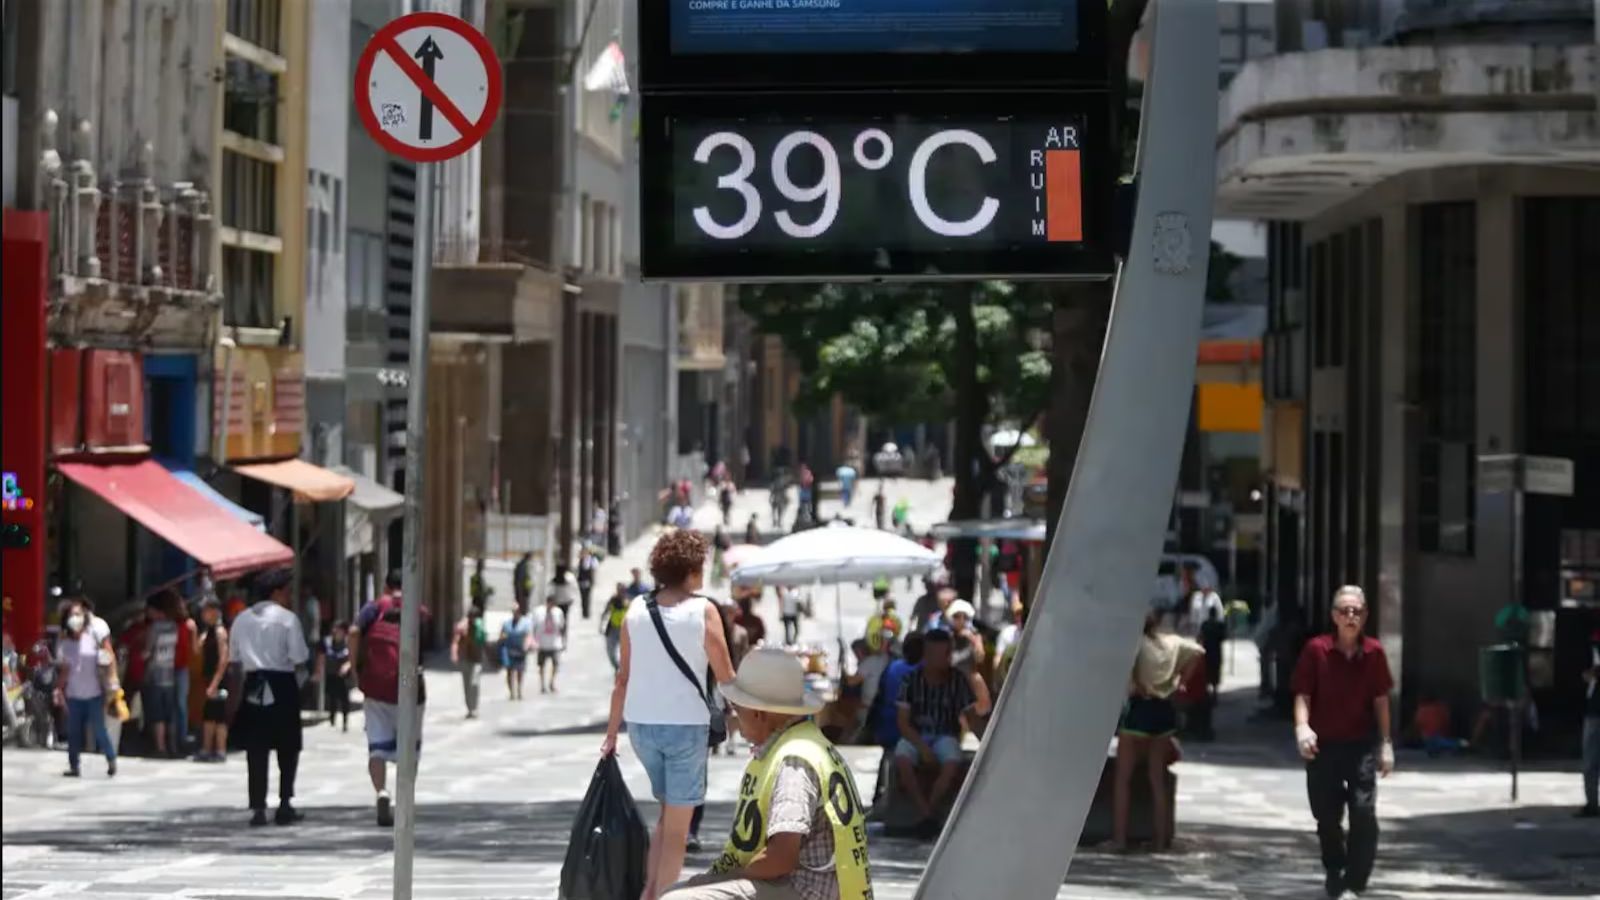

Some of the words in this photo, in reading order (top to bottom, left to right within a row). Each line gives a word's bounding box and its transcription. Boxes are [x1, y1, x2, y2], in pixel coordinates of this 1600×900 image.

[688, 0, 728, 10] COMPRE
[731, 0, 738, 9] E
[739, 0, 774, 9] GANHE
[776, 0, 790, 9] DA
[792, 0, 841, 8] SAMSUNG
[1045, 126, 1079, 148] AR
[1030, 149, 1045, 236] RUIM
